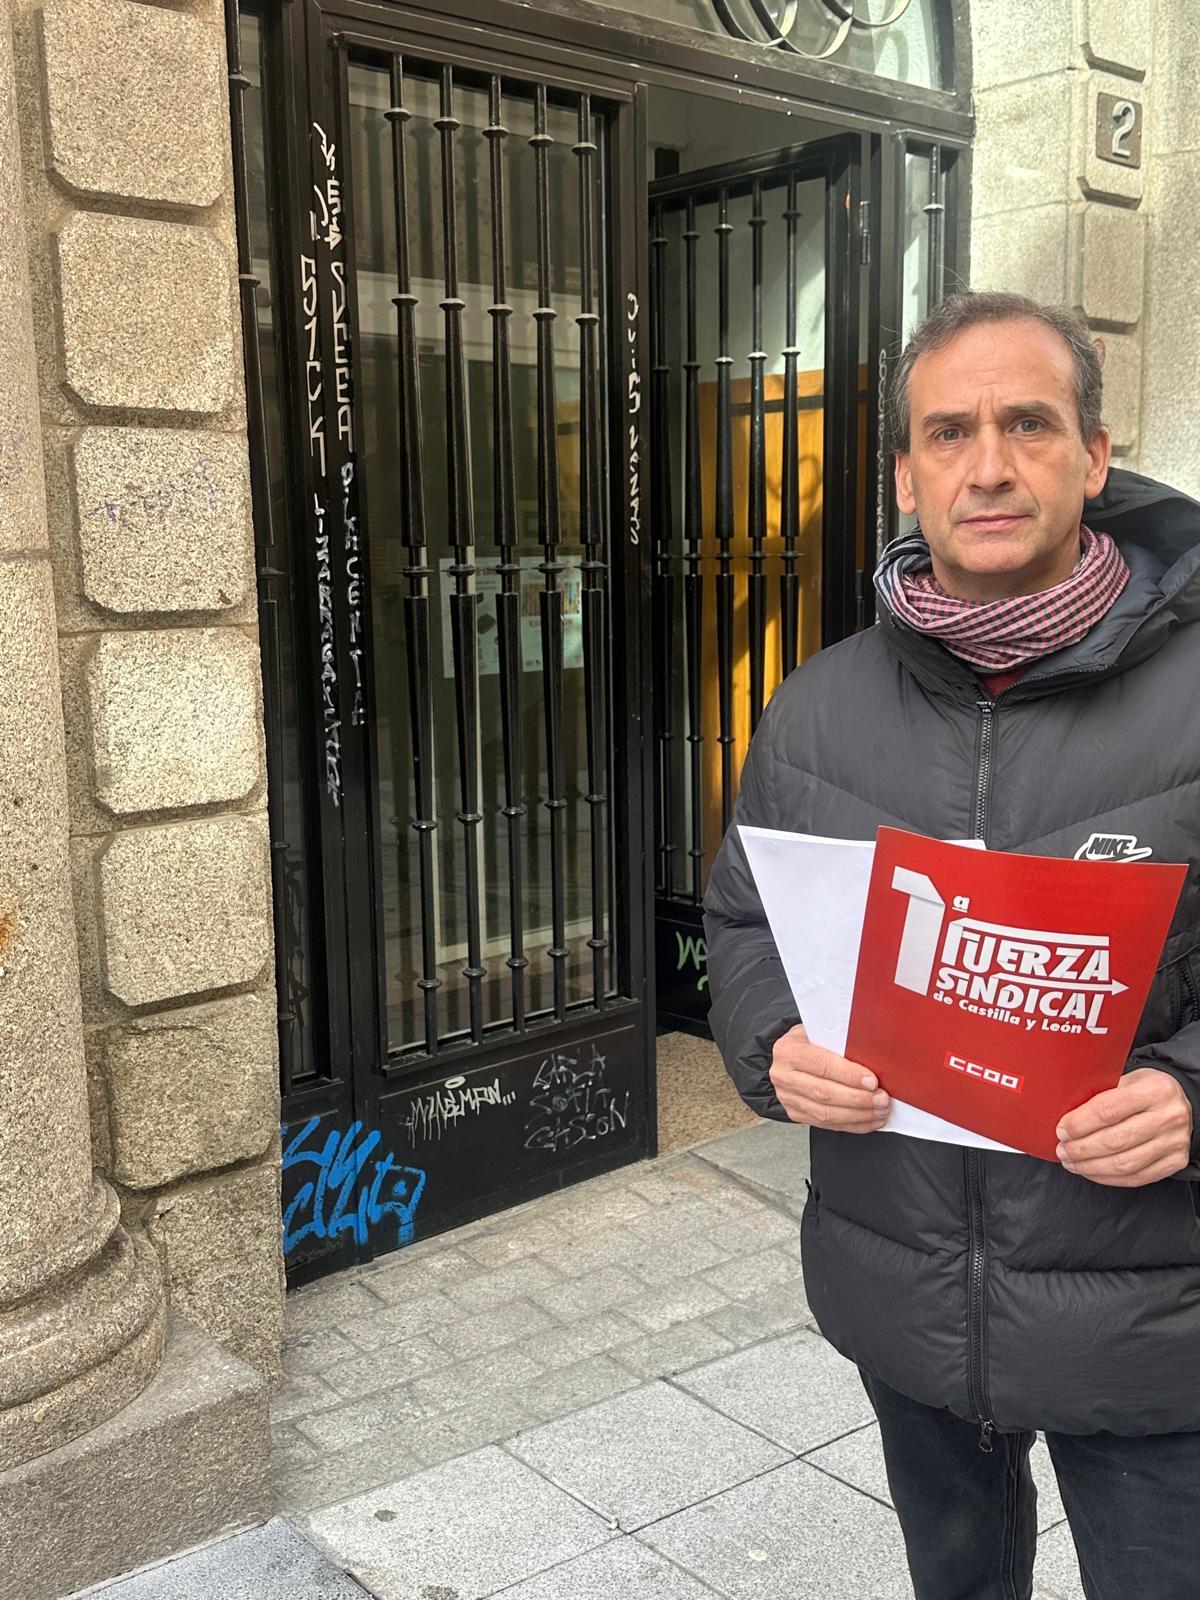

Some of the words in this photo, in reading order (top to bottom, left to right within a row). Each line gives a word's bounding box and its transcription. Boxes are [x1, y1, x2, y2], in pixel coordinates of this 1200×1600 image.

[1111, 100, 1136, 159] 2
[1087, 837, 1133, 855] NIKE
[941, 917, 1110, 981] FUERZA
[932, 990, 954, 1006] de
[958, 998, 1021, 1026] Castilla
[1024, 1018, 1038, 1031] y
[1041, 1018, 1083, 1034] León
[935, 966, 1109, 1035] SINDICAL
[949, 1055, 1020, 1089] CCOO
